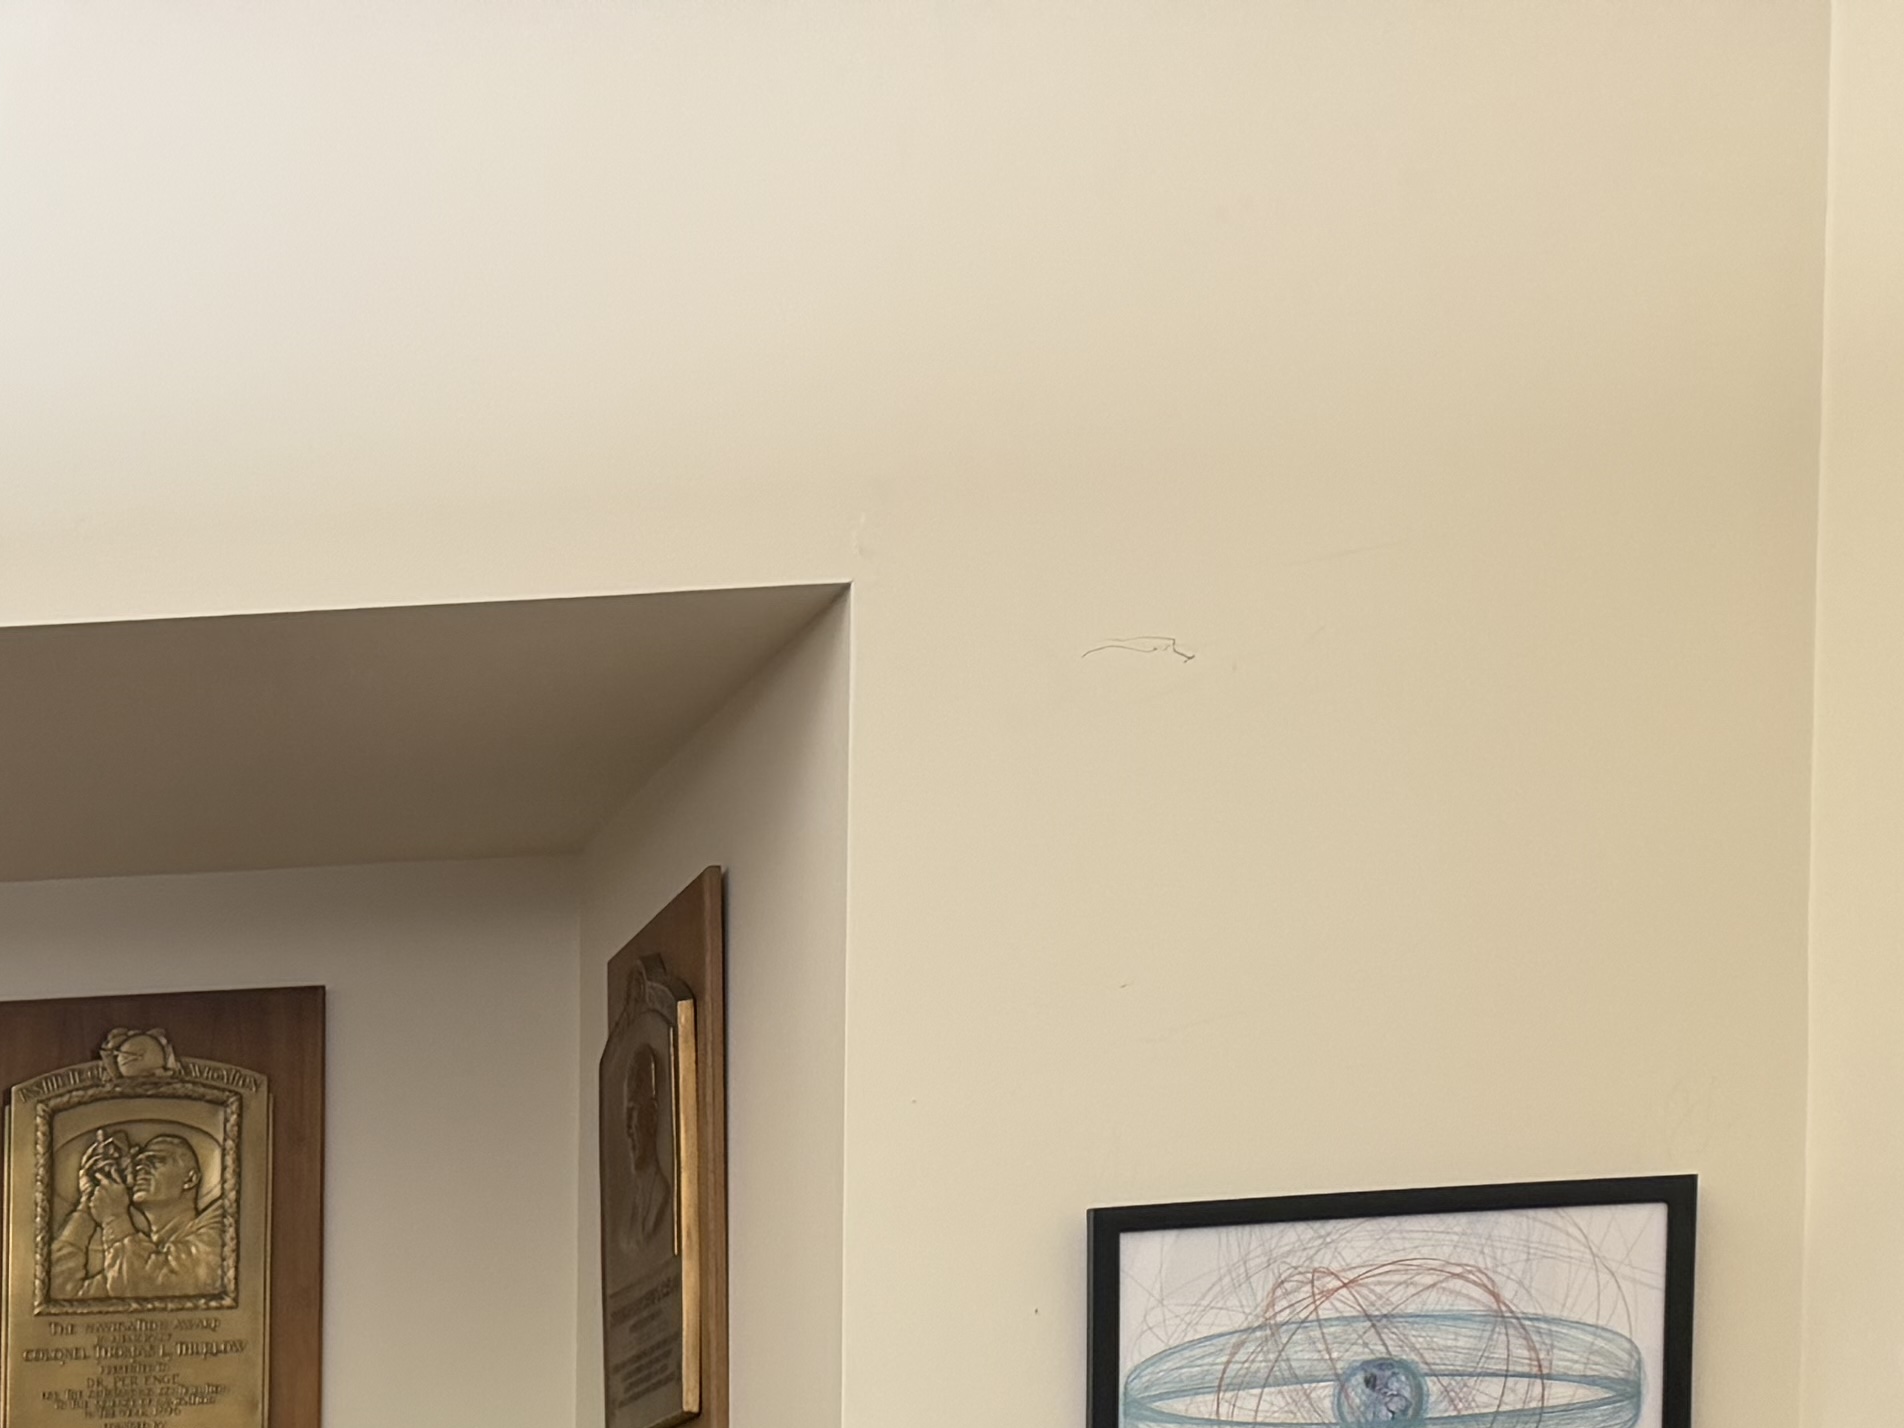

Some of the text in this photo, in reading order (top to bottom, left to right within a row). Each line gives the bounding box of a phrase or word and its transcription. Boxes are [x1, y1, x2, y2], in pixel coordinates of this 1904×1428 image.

[49, 1318, 221, 1336] THE NAVIGATION AWARD
[23, 1346, 90, 1366] COLONEL
[94, 1345, 157, 1364] THOMAS
[177, 1339, 246, 1360] THURLOW
[113, 1375, 138, 1387] PER
[144, 1373, 179, 1386] ENGE
